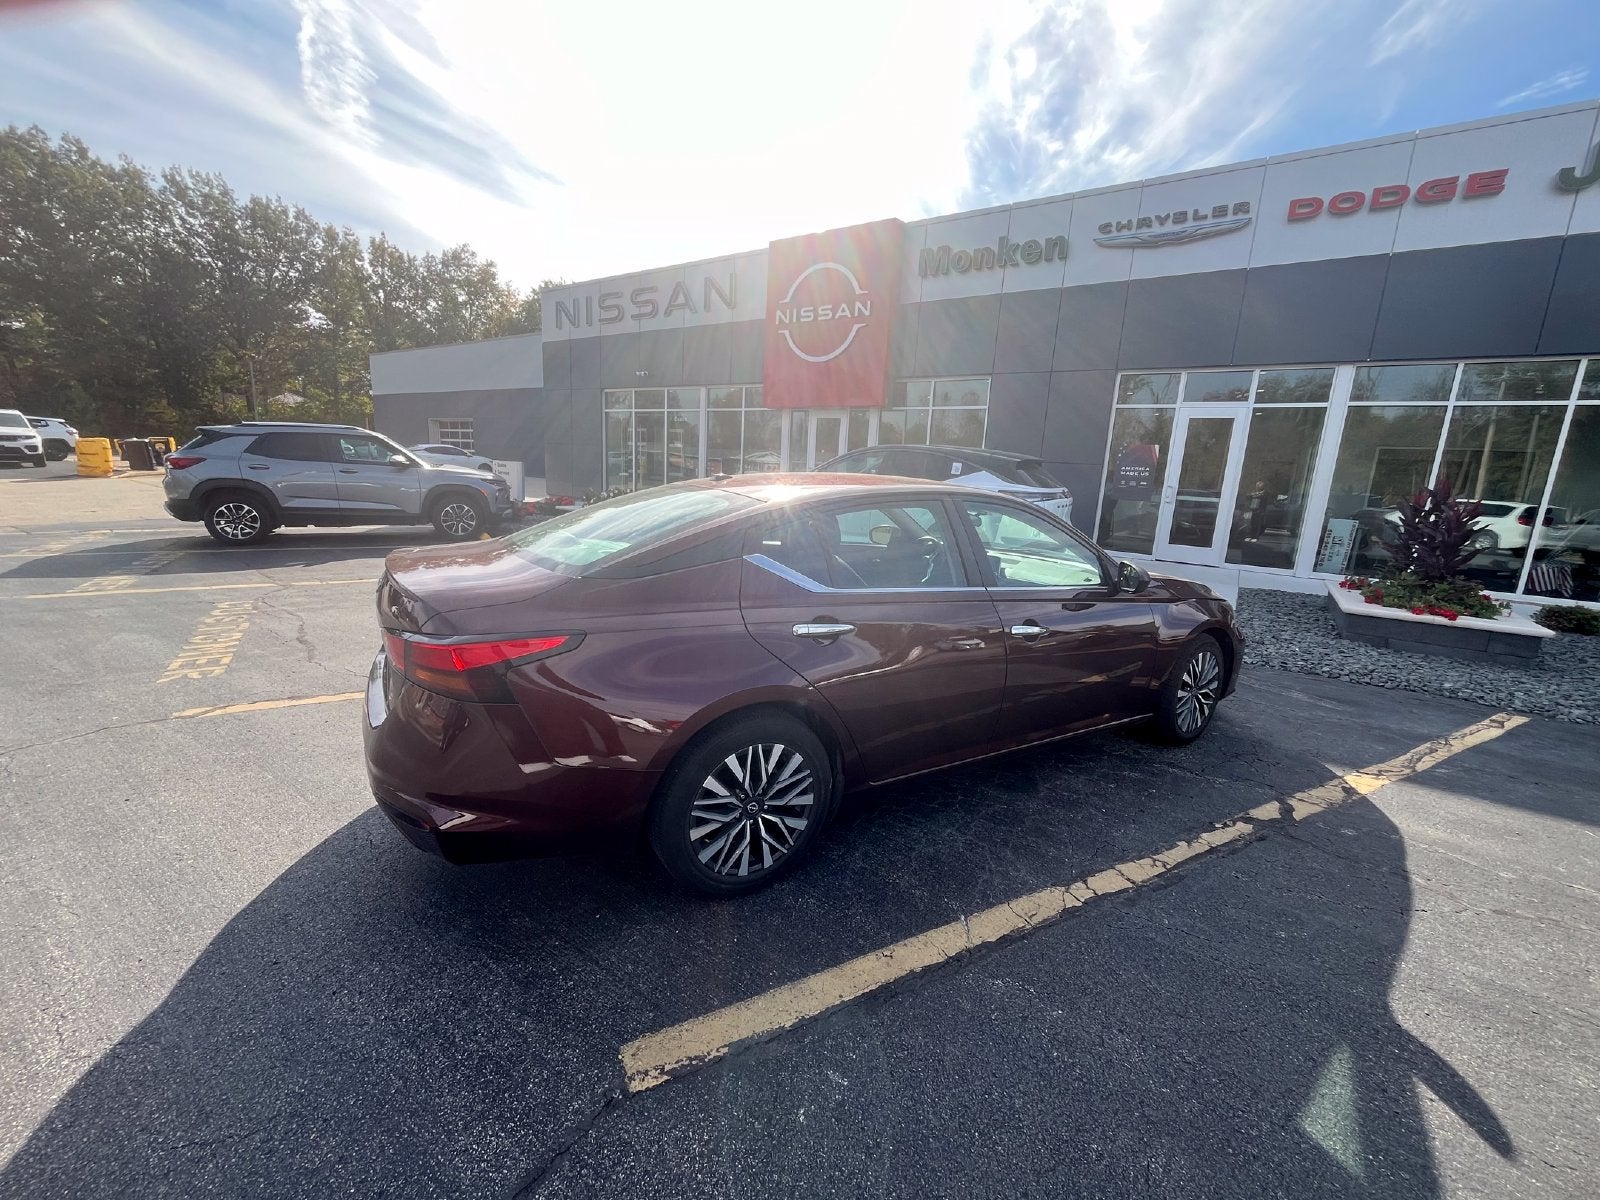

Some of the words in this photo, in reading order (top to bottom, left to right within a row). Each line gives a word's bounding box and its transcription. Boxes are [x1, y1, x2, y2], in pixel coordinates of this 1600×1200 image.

[1287, 168, 1509, 222] DODGE
[1097, 201, 1251, 235] CHRYSLER
[918, 234, 1068, 278] Monken
[555, 272, 737, 330] NISSAN
[775, 300, 871, 325] NISSAN
